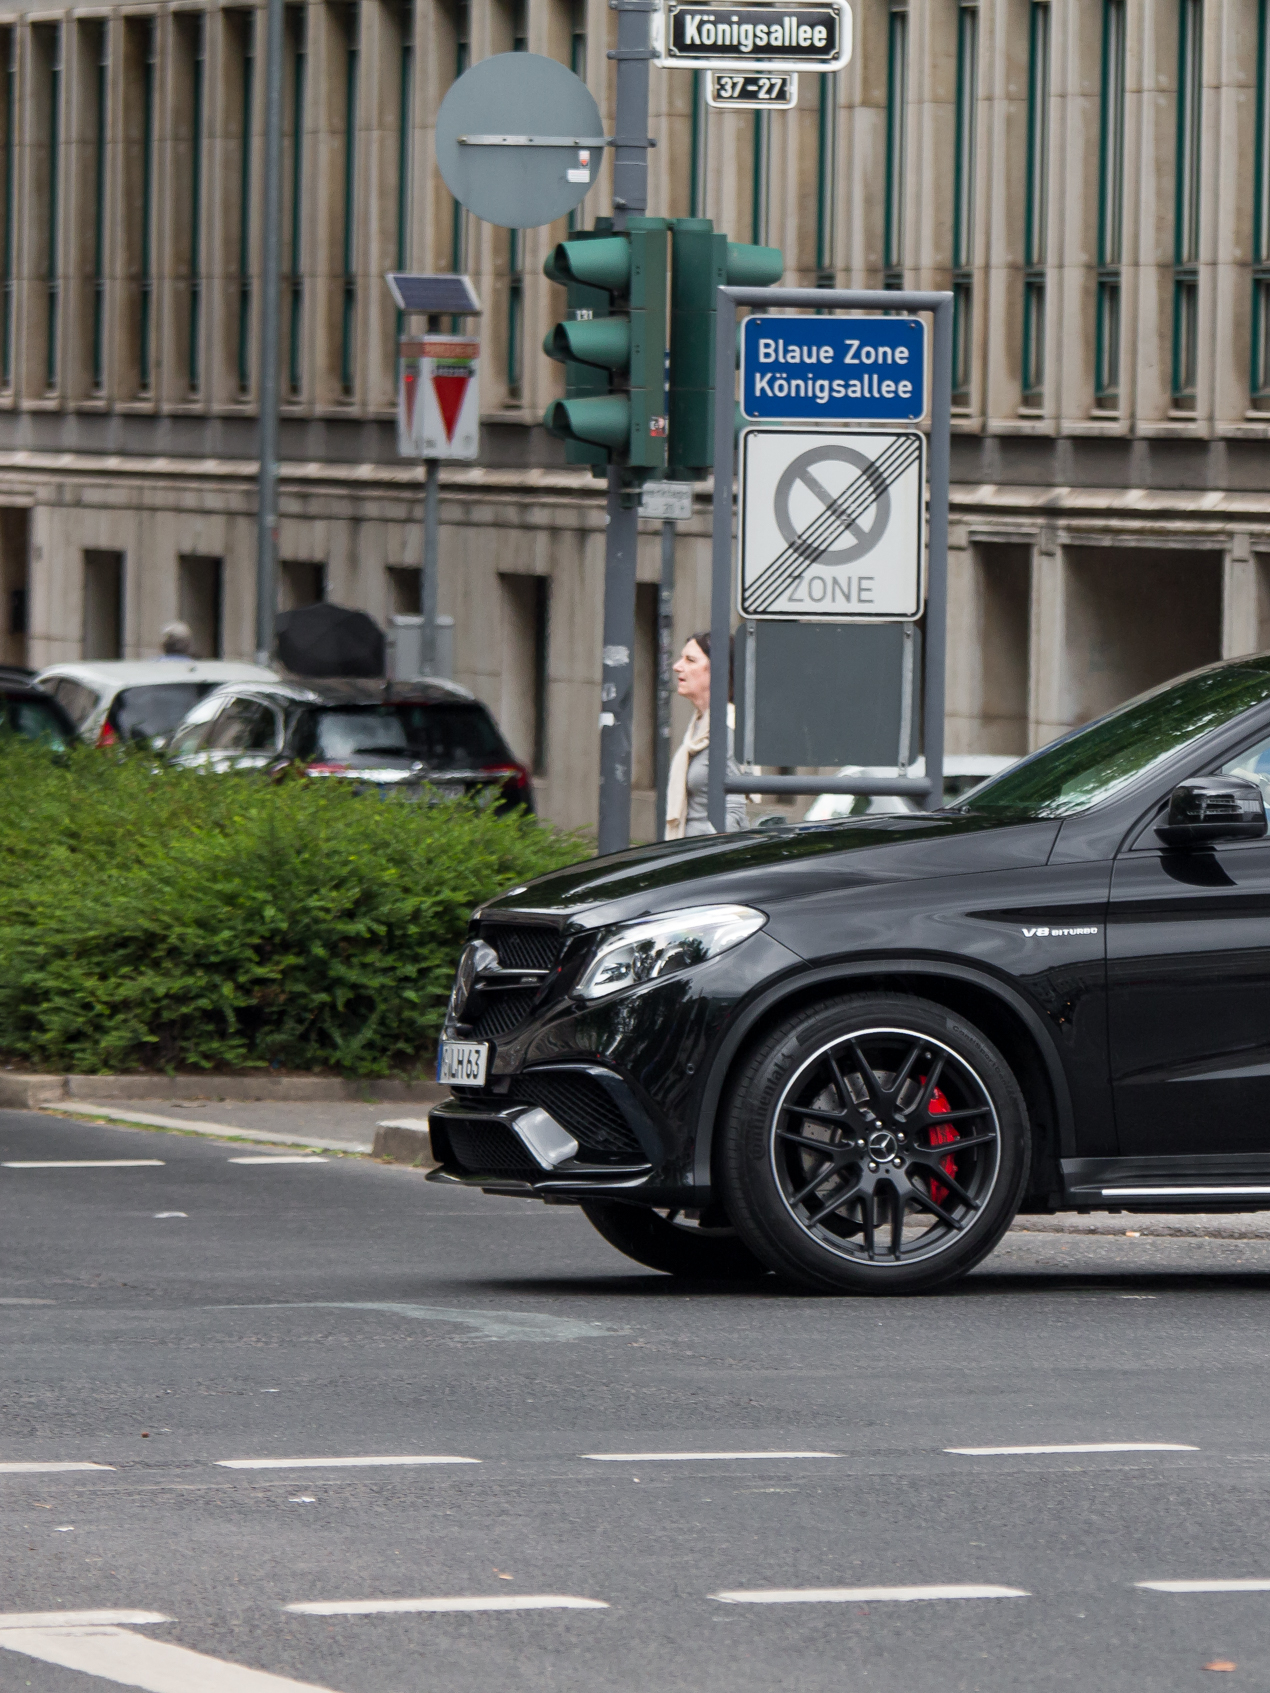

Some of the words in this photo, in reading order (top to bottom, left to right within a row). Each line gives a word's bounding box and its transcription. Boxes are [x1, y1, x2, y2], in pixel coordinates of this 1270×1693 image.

[684, 14, 828, 52] Königsallee
[758, 338, 834, 364] Blaue
[844, 339, 910, 365] Zone
[754, 372, 913, 404] Königsallee
[787, 575, 875, 604] ZONE
[1021, 927, 1050, 938] V8
[1051, 926, 1098, 937] BITURBO
